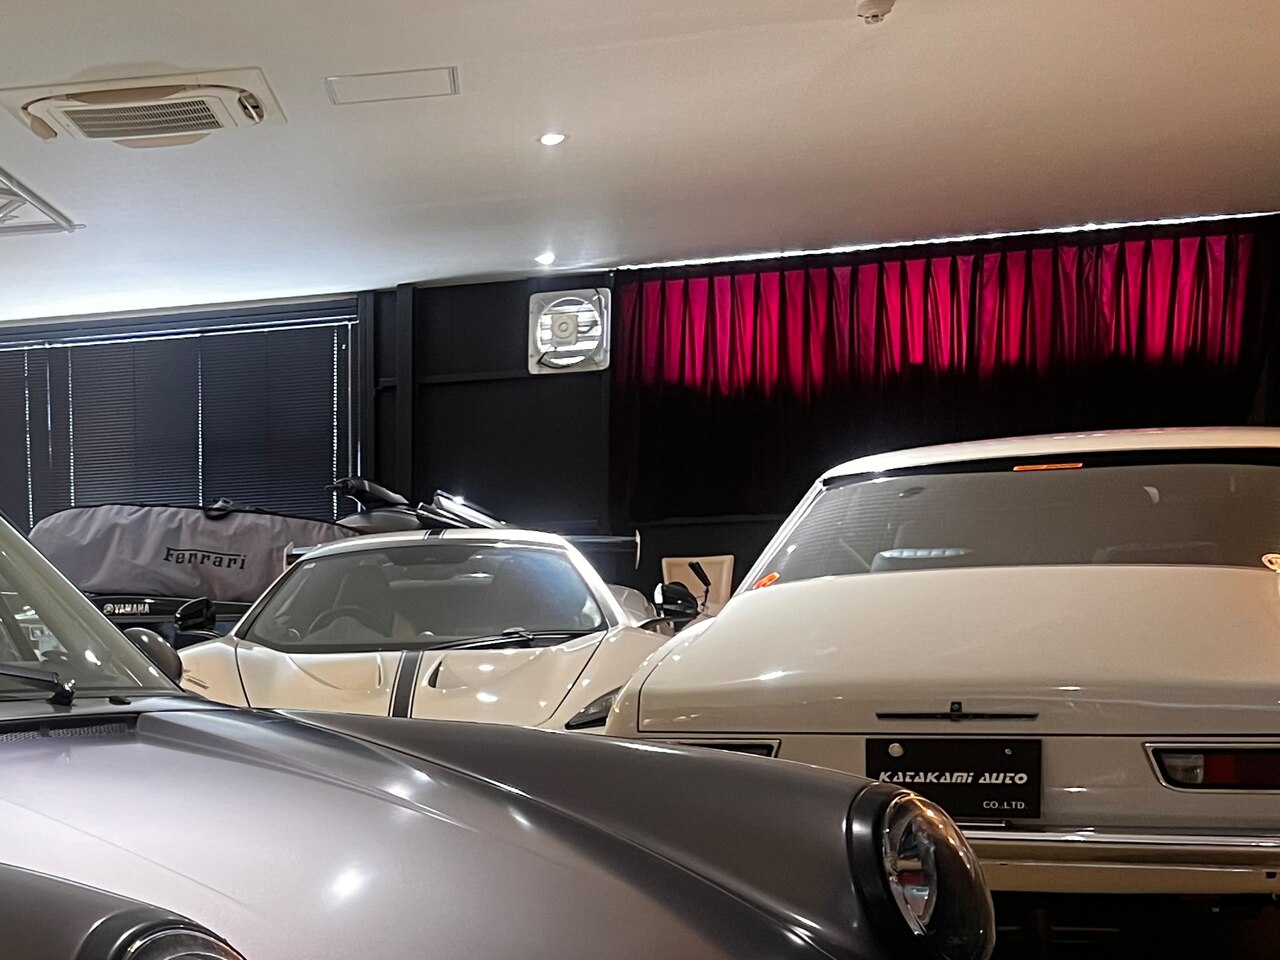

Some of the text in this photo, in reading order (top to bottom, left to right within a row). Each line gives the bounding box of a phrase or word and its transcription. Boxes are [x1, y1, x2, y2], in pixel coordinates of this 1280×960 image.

[163, 547, 247, 570] Ferrari
[114, 603, 150, 614] YAMAHA
[978, 772, 1028, 784] AUTO
